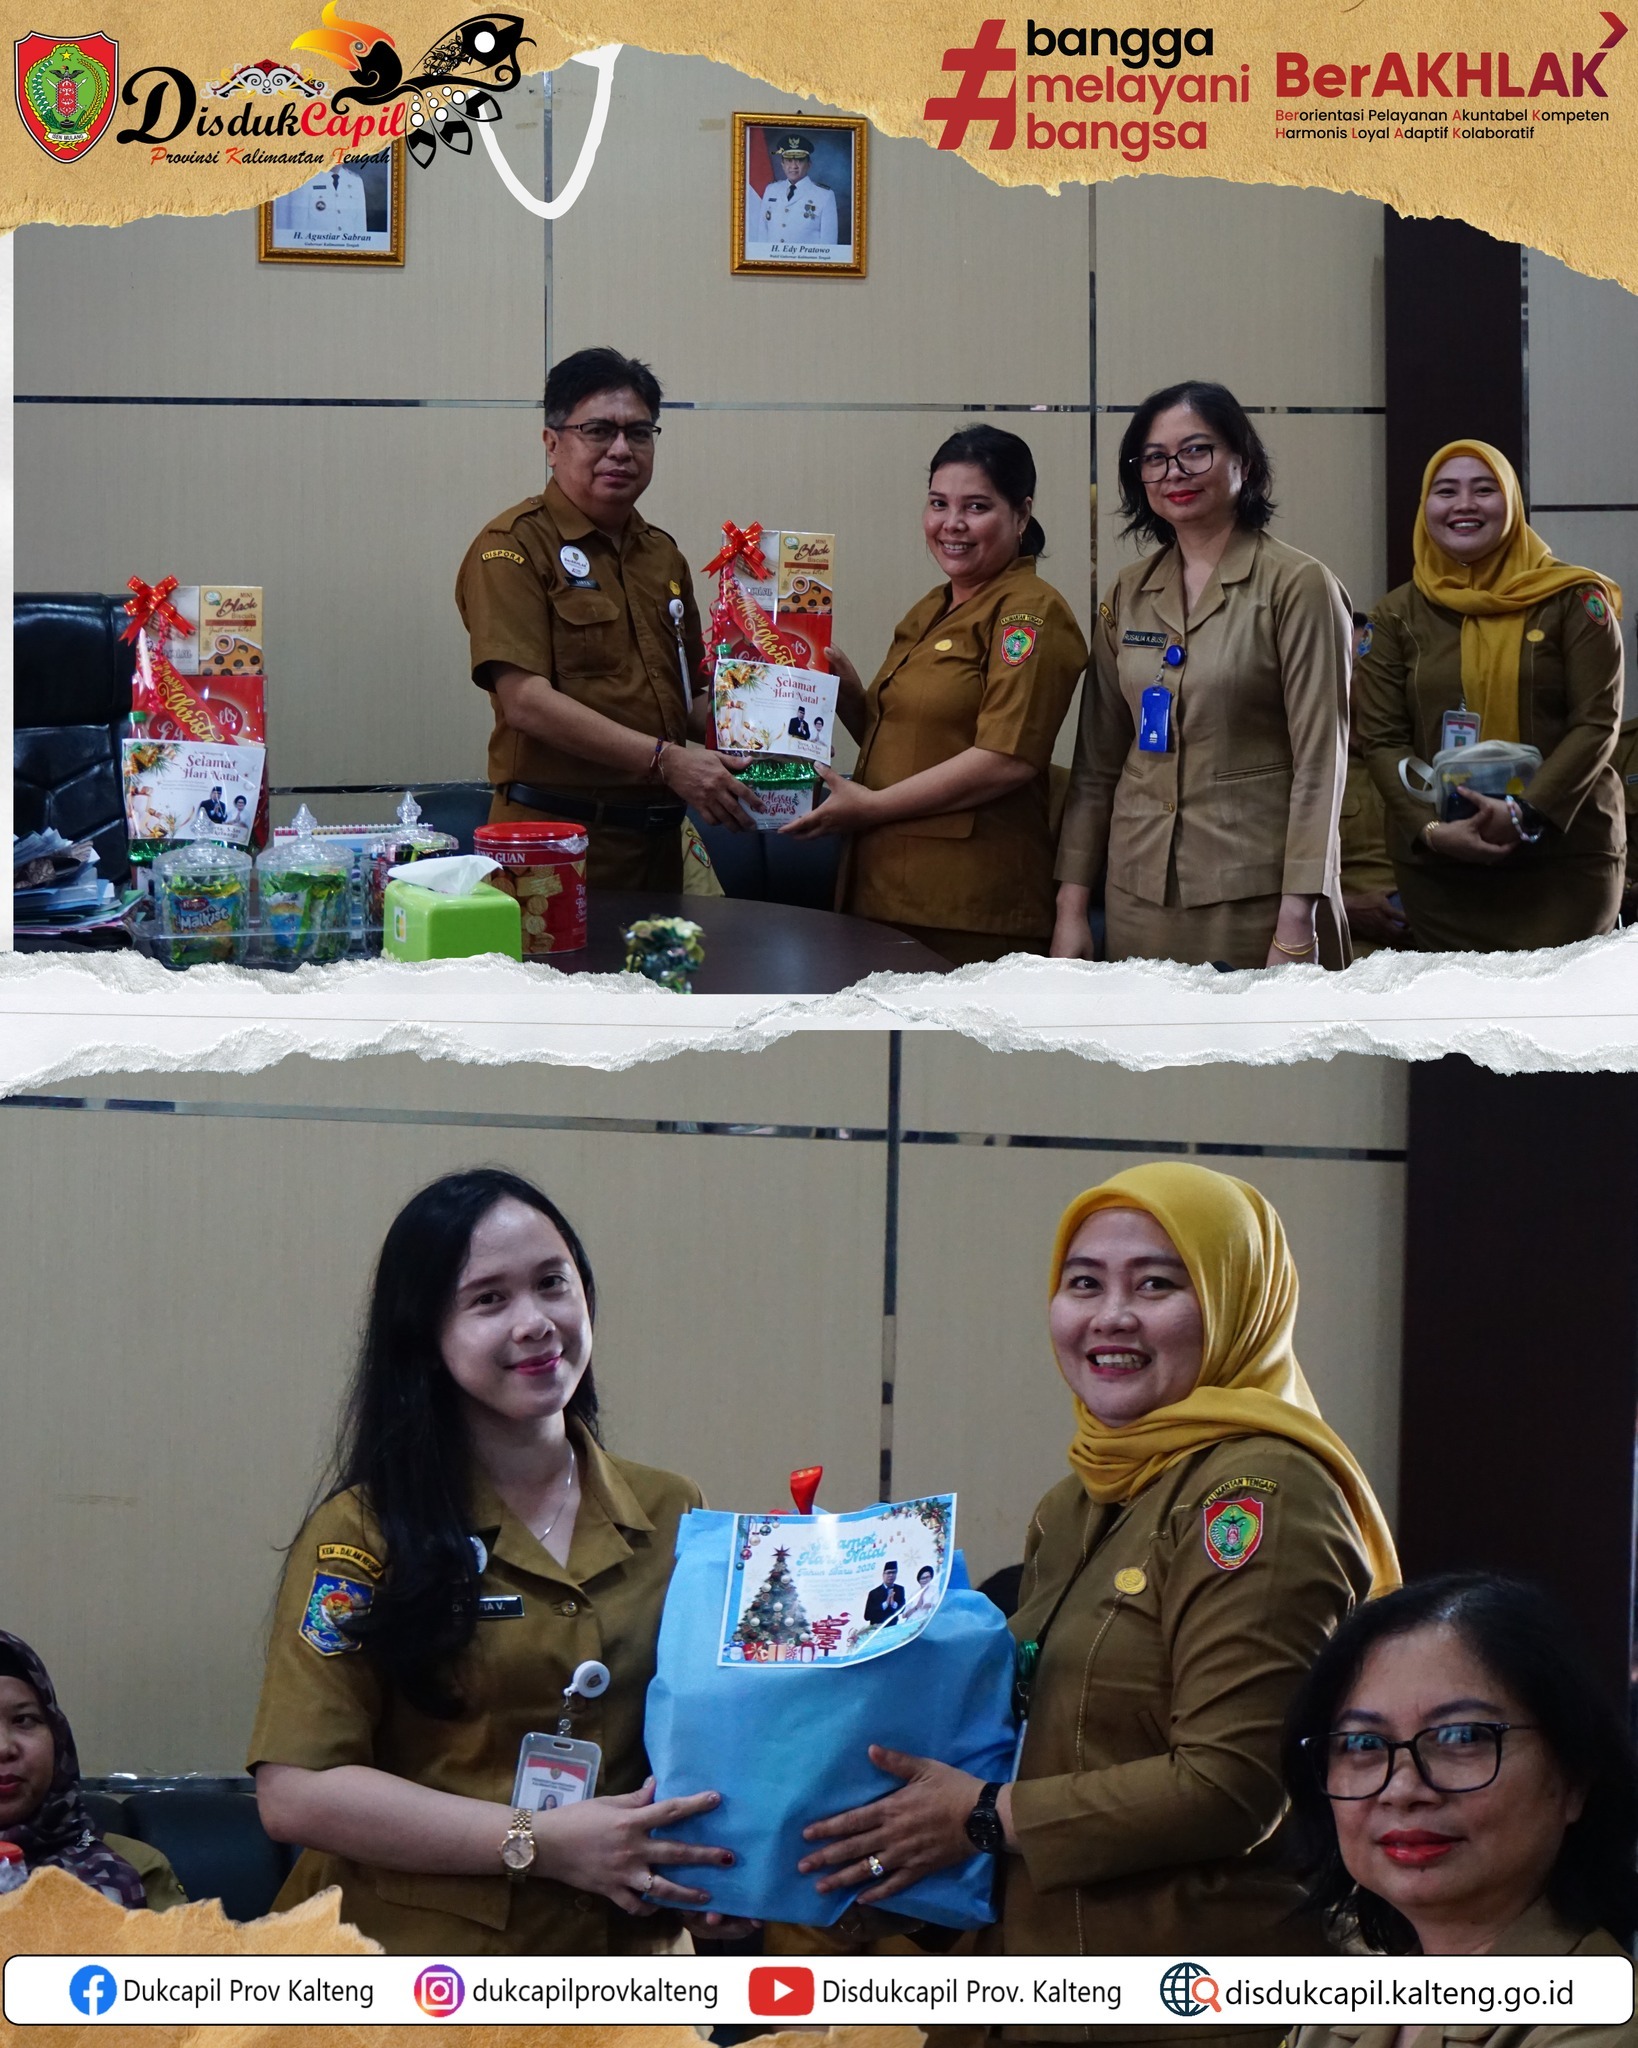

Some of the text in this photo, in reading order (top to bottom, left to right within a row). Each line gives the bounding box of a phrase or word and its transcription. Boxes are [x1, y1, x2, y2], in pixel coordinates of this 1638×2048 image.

[305, 232, 341, 241] Agustiar
[342, 233, 372, 241] Sabran
[783, 245, 798, 254] Edy
[799, 246, 830, 254] Pratowo
[484, 550, 522, 563] DISPORA
[794, 543, 831, 561] Black
[216, 597, 258, 618] Black
[775, 676, 817, 693] Selamat
[772, 688, 795, 698] Hari
[795, 691, 819, 705] Natal
[186, 754, 238, 769] Selamat
[495, 852, 526, 864] GUAN
[180, 905, 229, 931] Malkist
